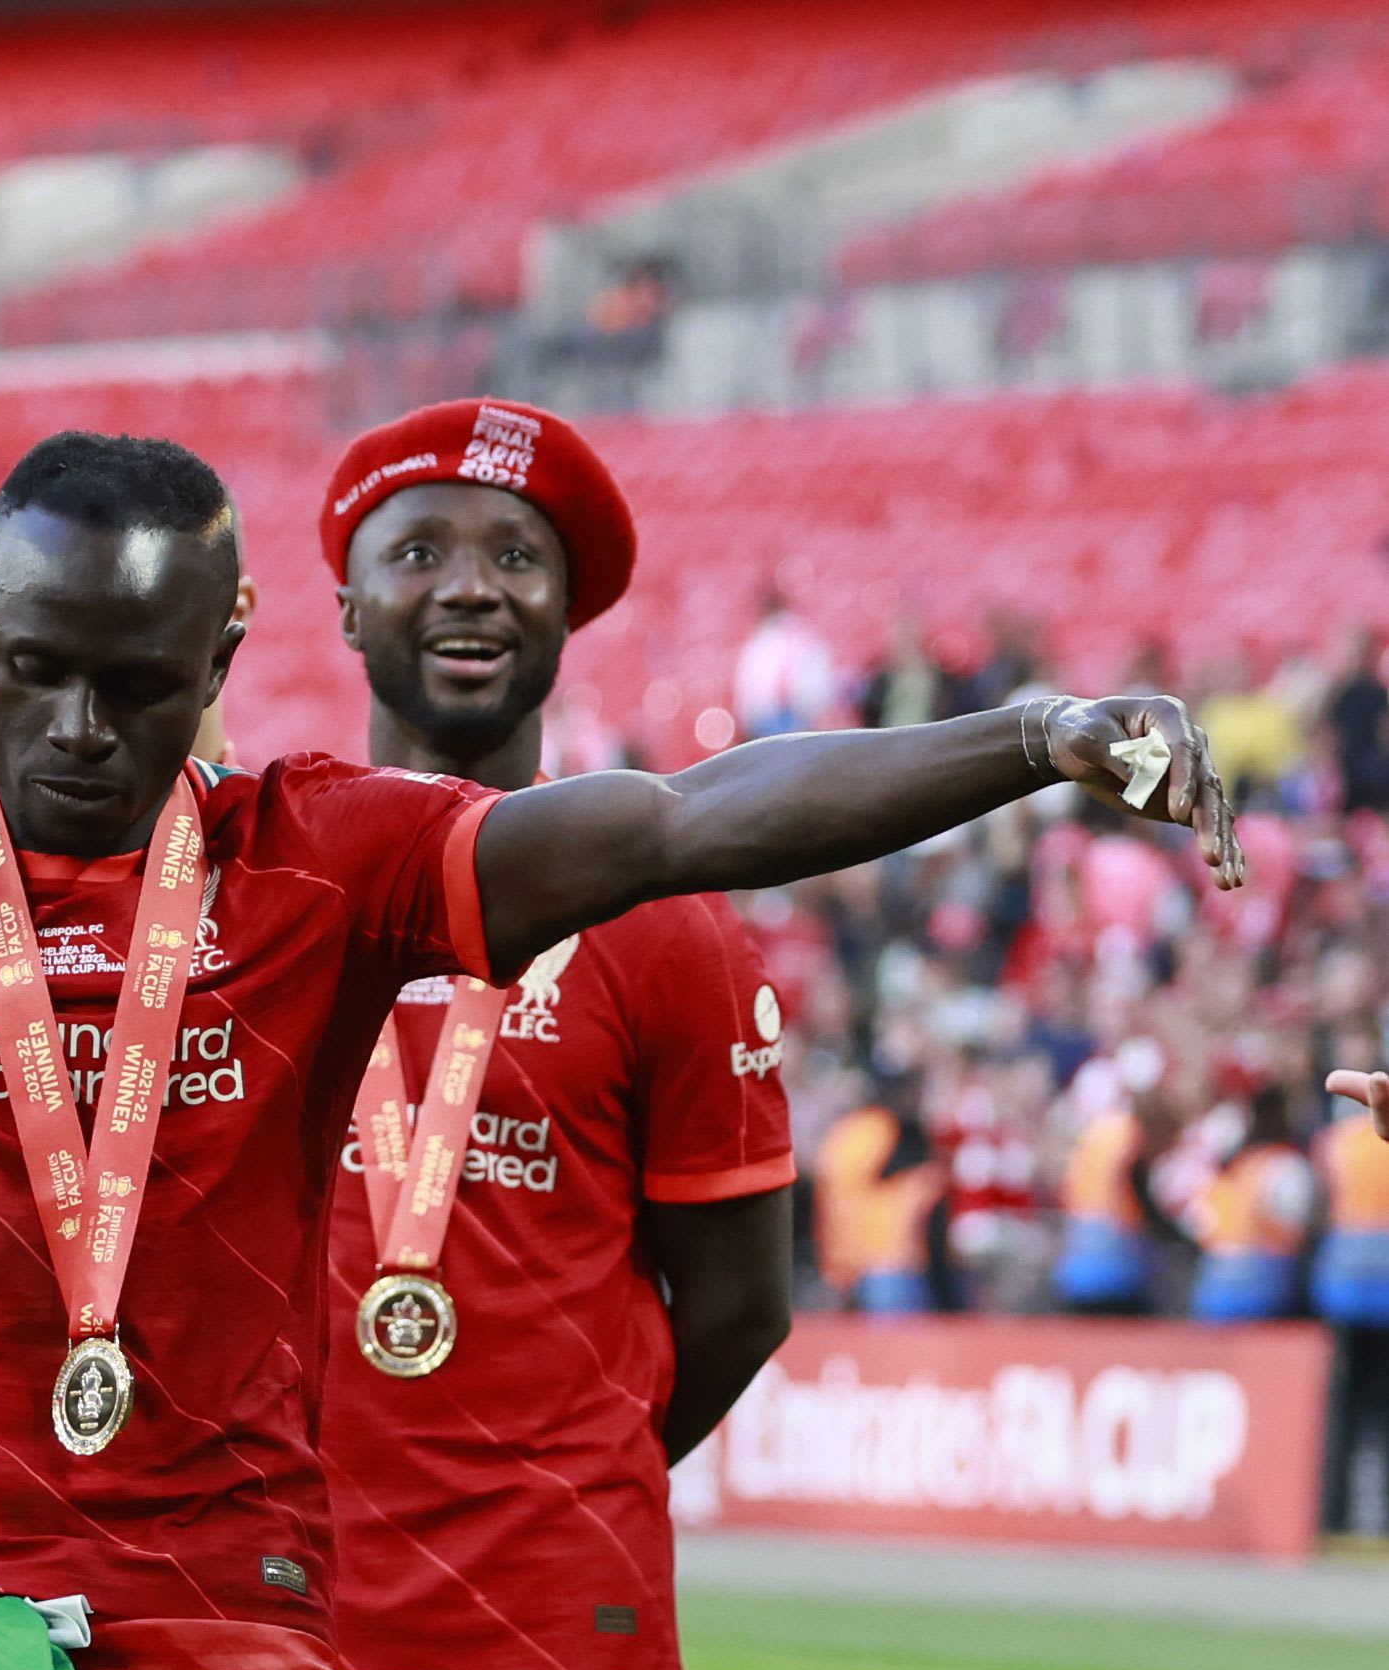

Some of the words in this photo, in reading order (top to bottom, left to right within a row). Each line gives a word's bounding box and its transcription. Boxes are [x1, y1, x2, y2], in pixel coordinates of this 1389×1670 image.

[159, 814, 194, 890] WINNER
[180, 830, 201, 884] 2021-22
[0, 902, 18, 934] CUP
[38, 925, 88, 937] VERPOOL
[89, 924, 104, 934] FC
[7, 934, 24, 955] FA
[40, 945, 80, 956] HELSEA
[81, 944, 96, 953] FC
[53, 954, 77, 965] MAY
[79, 953, 106, 963] 2022
[56, 965, 70, 974] FA
[71, 964, 96, 974] CUP
[147, 953, 162, 972] FA
[140, 973, 159, 1009] CUP
[155, 956, 177, 1009] Emirates
[16, 1037, 42, 1103] 2021-22
[28, 1019, 64, 1113] WINNER
[110, 1043, 144, 1134] WINNER
[132, 1058, 157, 1123] 2021-22
[47, 1152, 68, 1211] Emirates
[59, 1149, 78, 1184] CUP
[69, 1184, 83, 1207] FA
[96, 1204, 113, 1226] FA
[91, 1228, 108, 1263] CUP
[103, 1206, 126, 1263] Emirates
